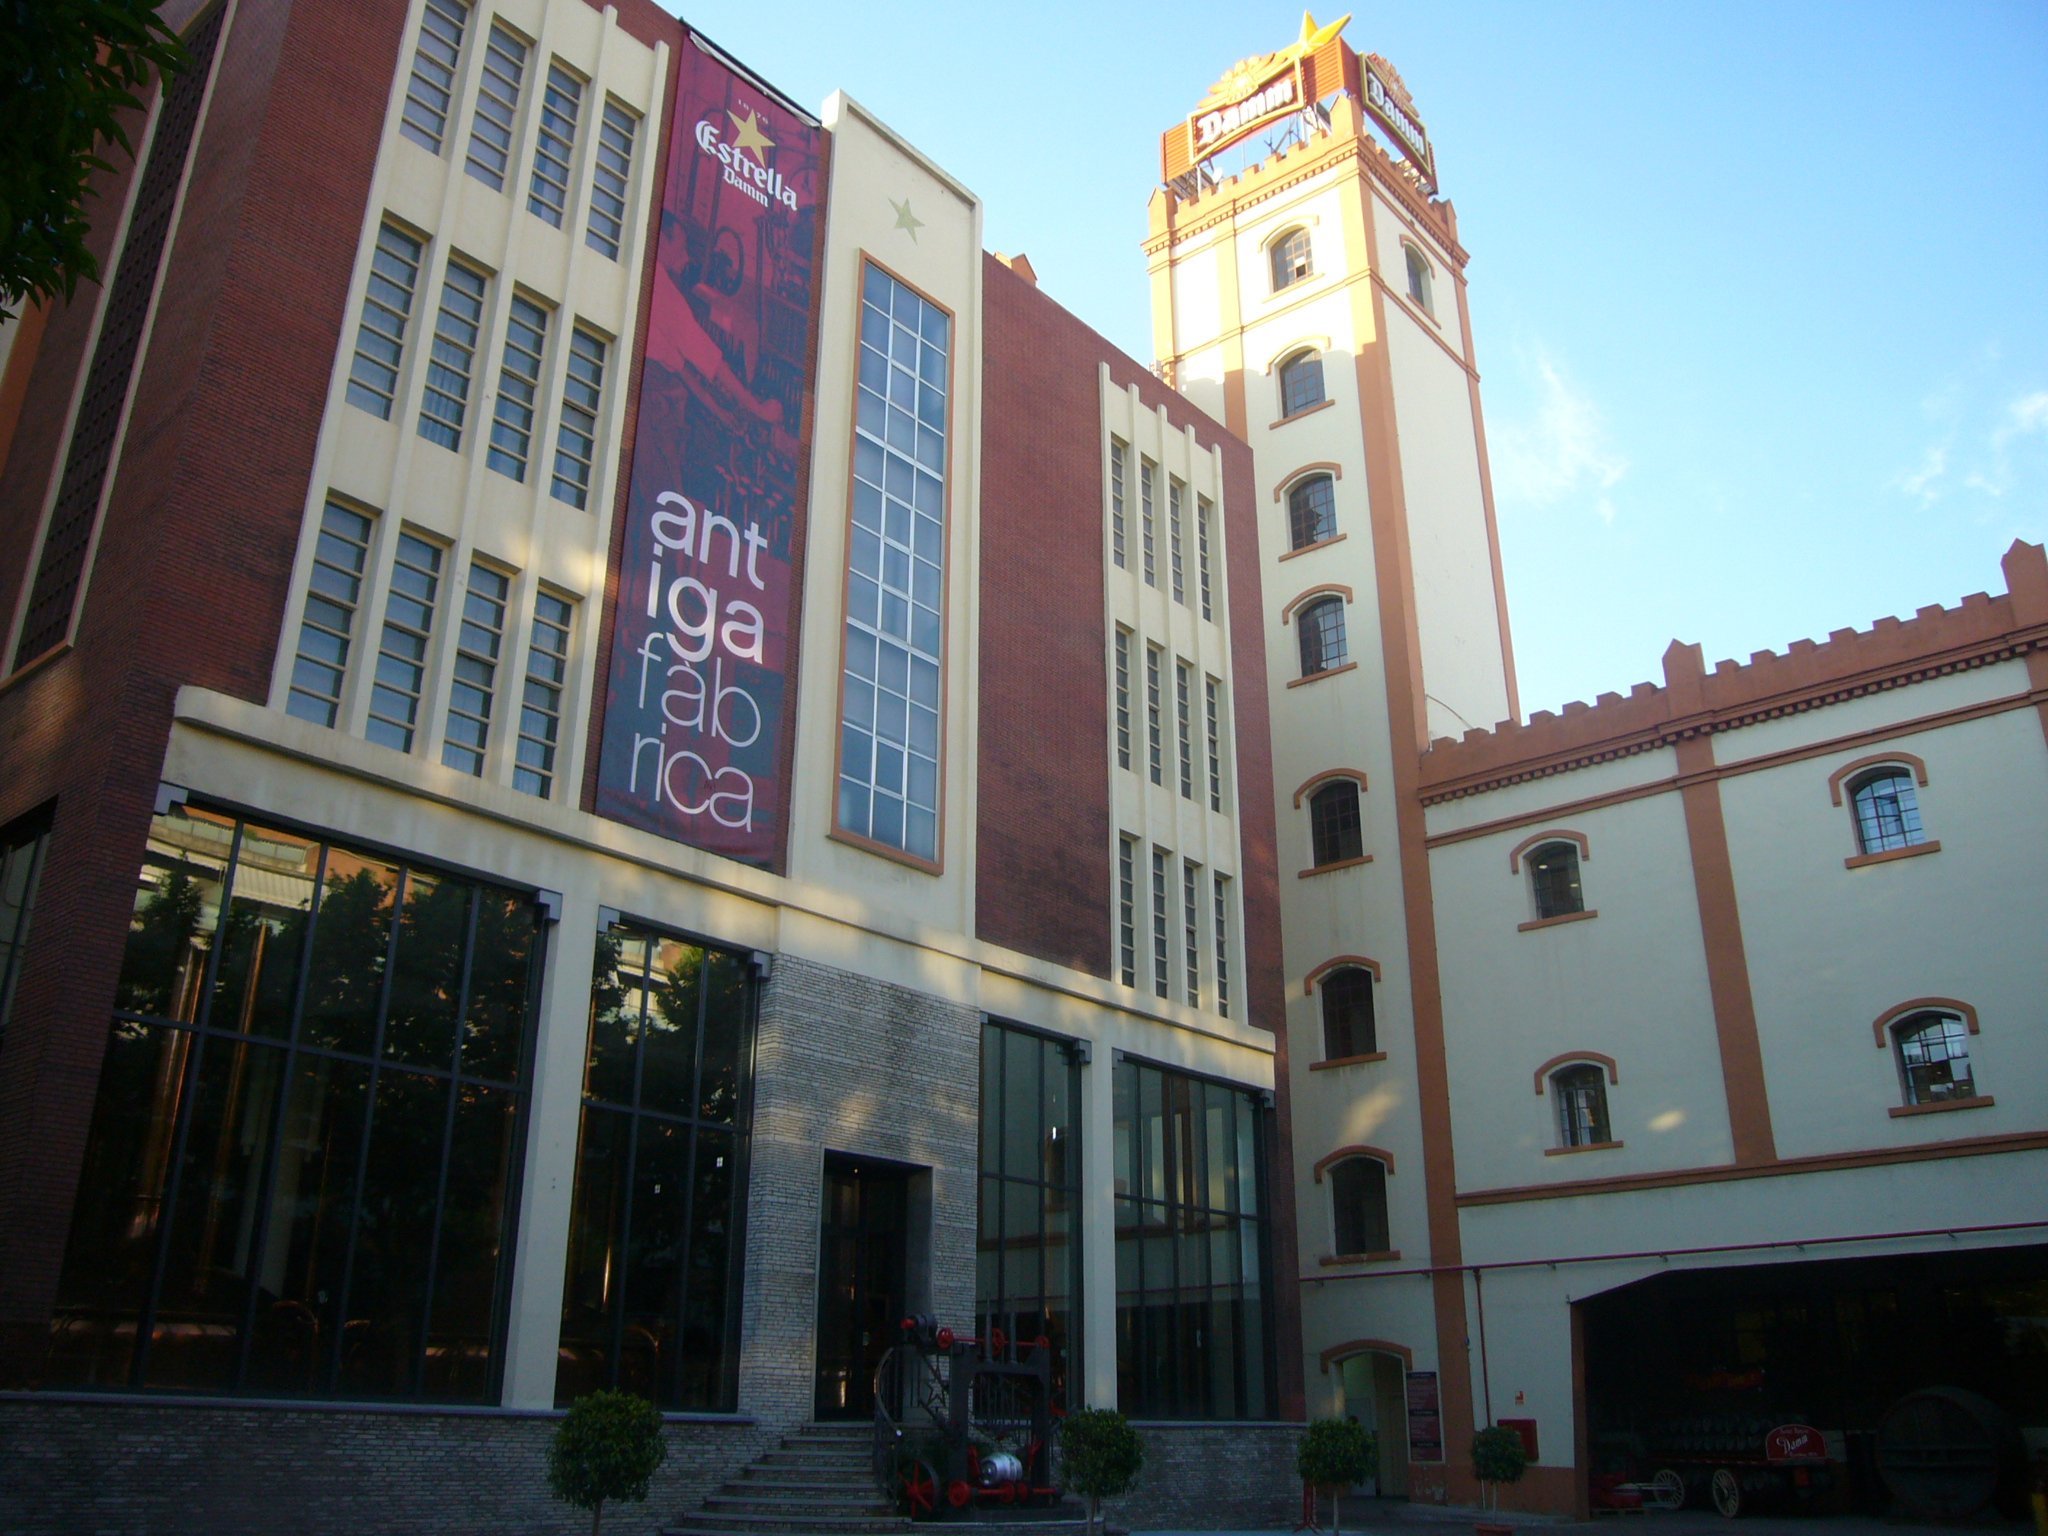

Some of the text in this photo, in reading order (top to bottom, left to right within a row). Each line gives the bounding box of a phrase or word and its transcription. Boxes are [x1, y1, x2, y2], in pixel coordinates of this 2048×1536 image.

[1197, 78, 1293, 147] Damm
[1367, 72, 1426, 157] Damm
[695, 120, 798, 212] Estrella
[723, 164, 769, 208] Damm
[651, 490, 768, 591] ant
[647, 542, 765, 665] iga
[637, 632, 761, 748] fàb
[630, 722, 754, 833] rica
